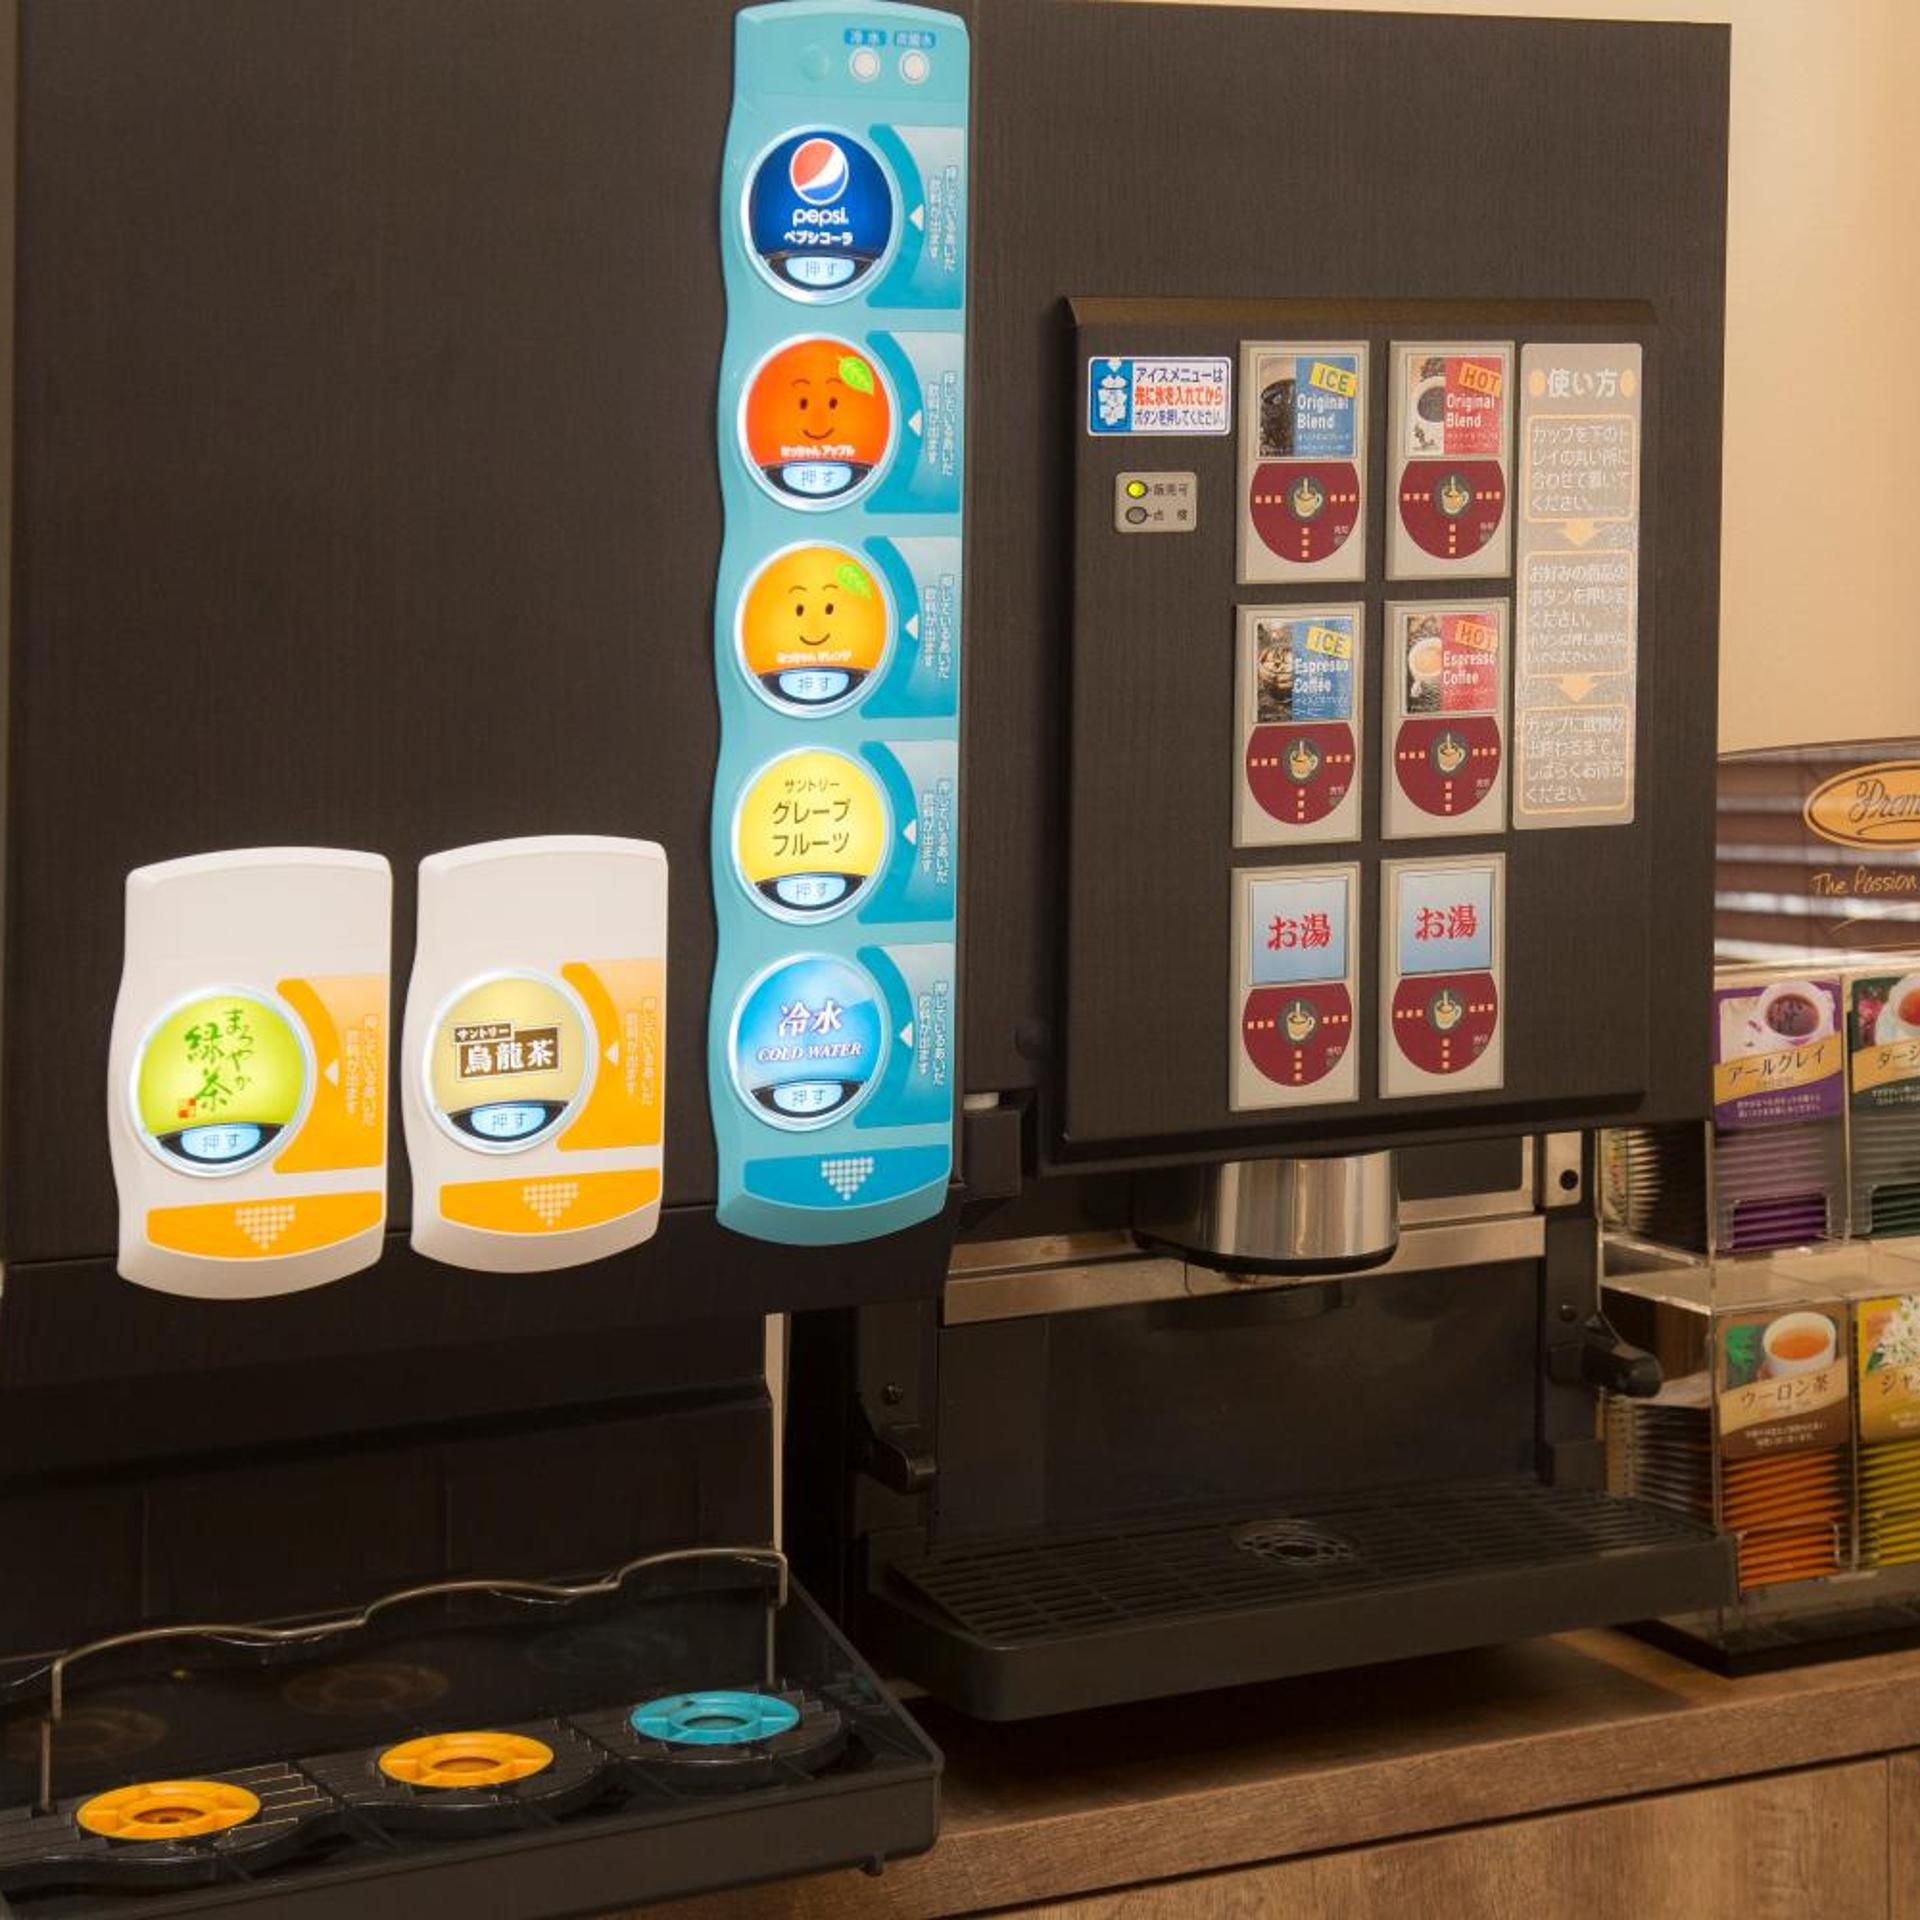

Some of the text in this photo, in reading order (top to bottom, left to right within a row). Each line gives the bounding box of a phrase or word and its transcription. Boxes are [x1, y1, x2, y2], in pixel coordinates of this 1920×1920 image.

[792, 208, 848, 225] pepsi
[784, 230, 853, 246] ペプシコーラ
[1136, 367, 1223, 383] アイスメニューは
[1318, 366, 1350, 393] ICE
[1463, 365, 1500, 391] HOT
[1547, 368, 1617, 398] 使い方
[1297, 393, 1349, 413] Original
[1446, 393, 1495, 412] Original
[1297, 413, 1335, 429] Blend
[1446, 412, 1482, 428] Blend
[801, 469, 834, 487] 押す
[1314, 631, 1346, 655] ICE
[1443, 651, 1496, 668] Espresso
[798, 676, 831, 693] 押す
[1443, 669, 1479, 686] Coffee
[784, 778, 841, 793] サントリー
[772, 799, 851, 825] グレープ
[771, 832, 850, 857] フルーツ
[1811, 865, 1917, 895] The Passion
[795, 883, 828, 901] 押す
[1268, 913, 1331, 950] お湯
[1415, 904, 1478, 941] お湯
[779, 1001, 844, 1037] 冷水
[456, 1026, 511, 1040] サントリー
[464, 1039, 554, 1074] 烏龍茶
[757, 1043, 863, 1063] COLD WATER
[185, 1022, 233, 1112] 緑茶
[1729, 1045, 1824, 1083] アールグレイ
[792, 1088, 827, 1106] 押す
[491, 1112, 528, 1132] 押す
[202, 1133, 241, 1152] 押す
[1741, 1373, 1829, 1409] ウーロン茶
